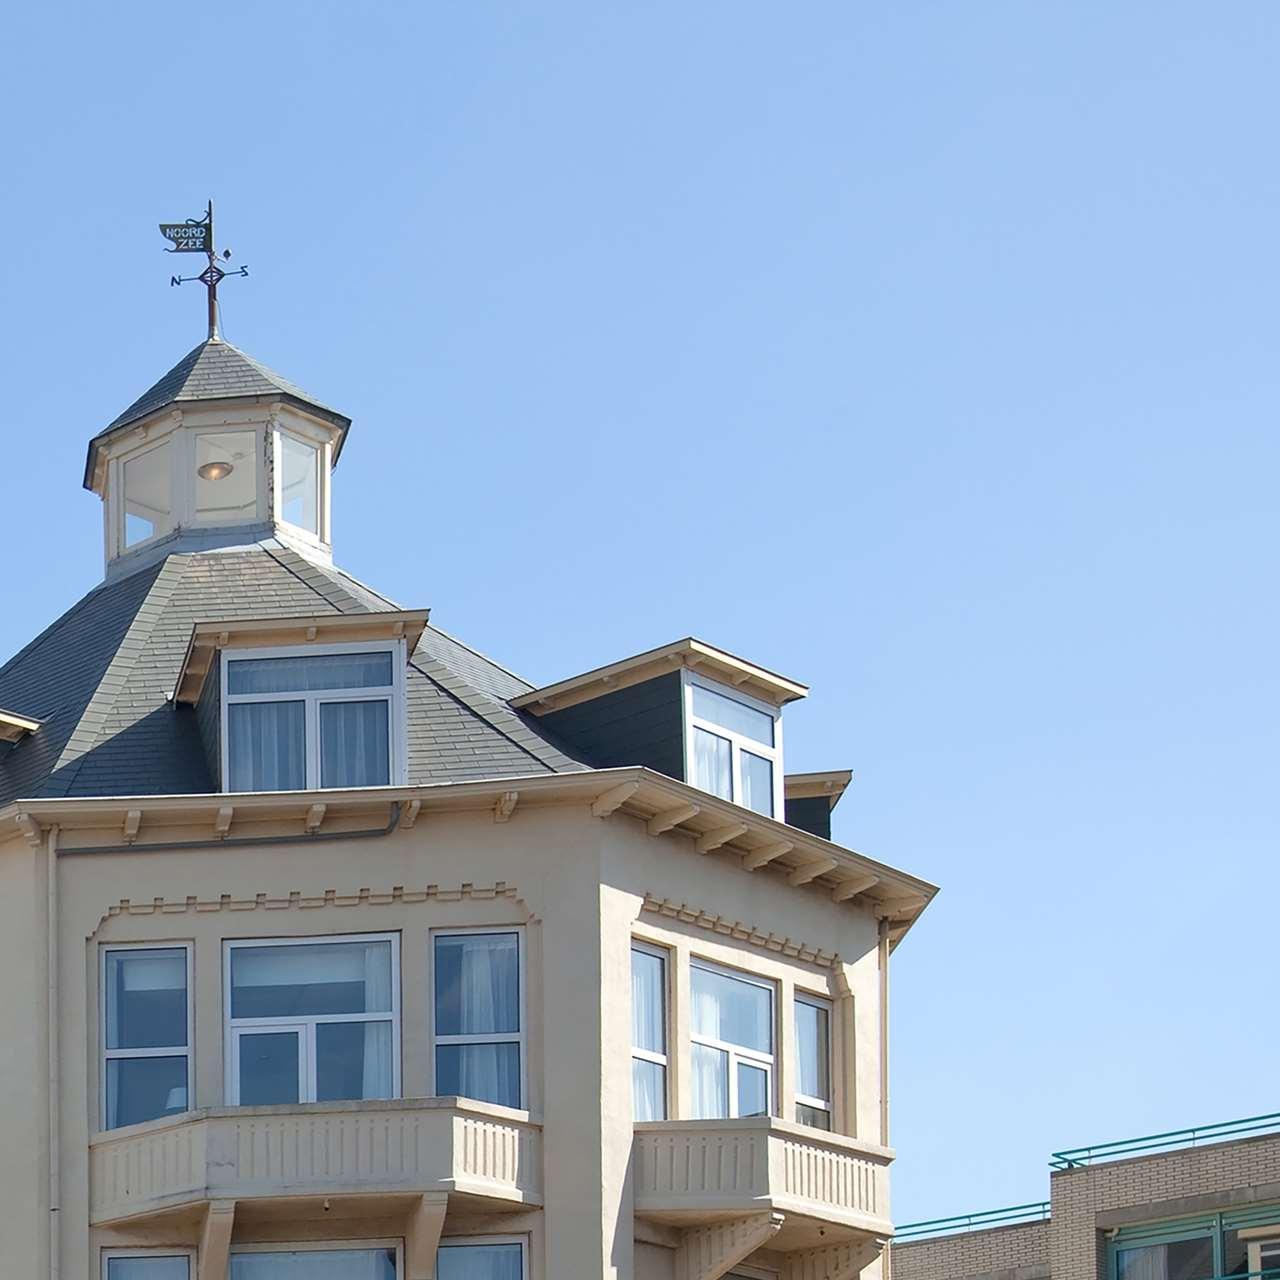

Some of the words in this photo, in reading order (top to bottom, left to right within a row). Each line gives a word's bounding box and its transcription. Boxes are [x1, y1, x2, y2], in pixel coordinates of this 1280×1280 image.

[165, 227, 206, 238] NOORD
[177, 238, 204, 249] ZEE
[170, 275, 181, 287] N
